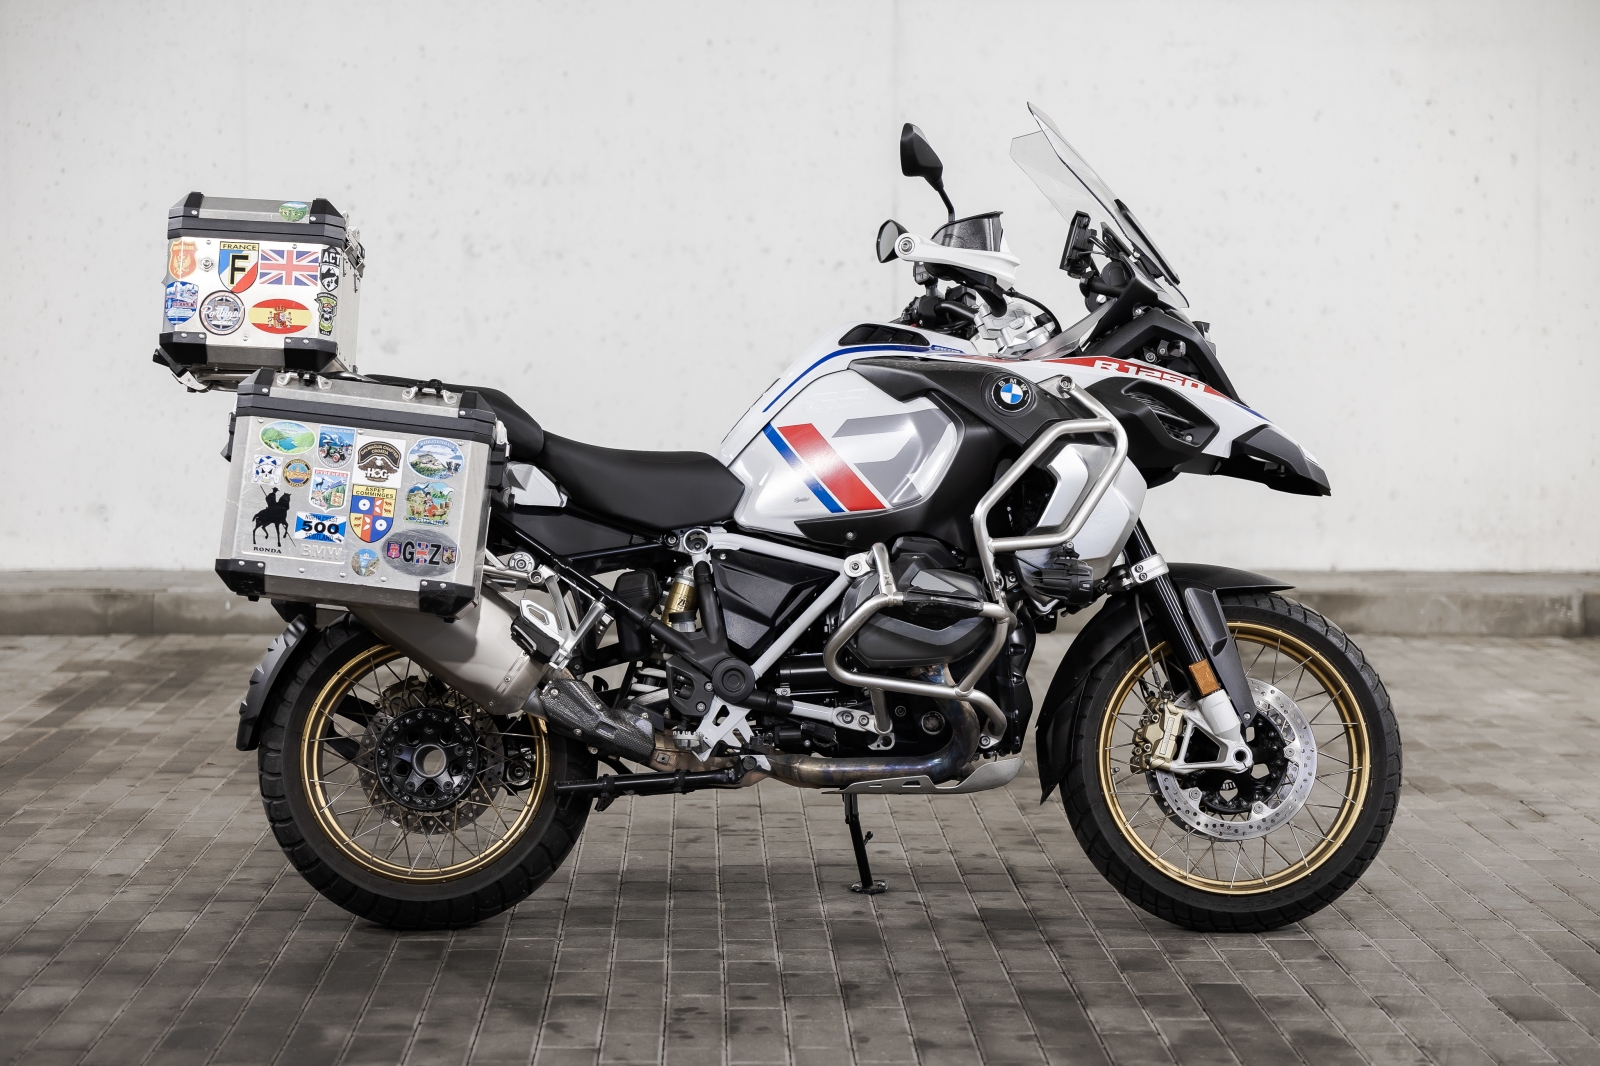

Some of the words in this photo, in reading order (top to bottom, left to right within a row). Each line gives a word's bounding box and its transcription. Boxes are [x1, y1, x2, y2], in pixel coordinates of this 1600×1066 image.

[222, 243, 258, 252] FRANCE
[322, 251, 341, 267] ACT
[230, 254, 249, 285] F
[200, 305, 245, 322] Portugal
[998, 377, 1029, 392] BMW
[1093, 360, 1121, 374] R
[1123, 364, 1206, 394] 1250
[315, 469, 349, 478] PYRENEES
[366, 467, 388, 479] HOG
[355, 490, 394, 500] COMMINGES
[304, 513, 320, 522] NORTH
[301, 520, 340, 535] 500
[305, 532, 334, 542] SCOTLAND
[253, 546, 282, 555] RONDA
[300, 544, 343, 561] BMW
[402, 541, 442, 566] GBZ
